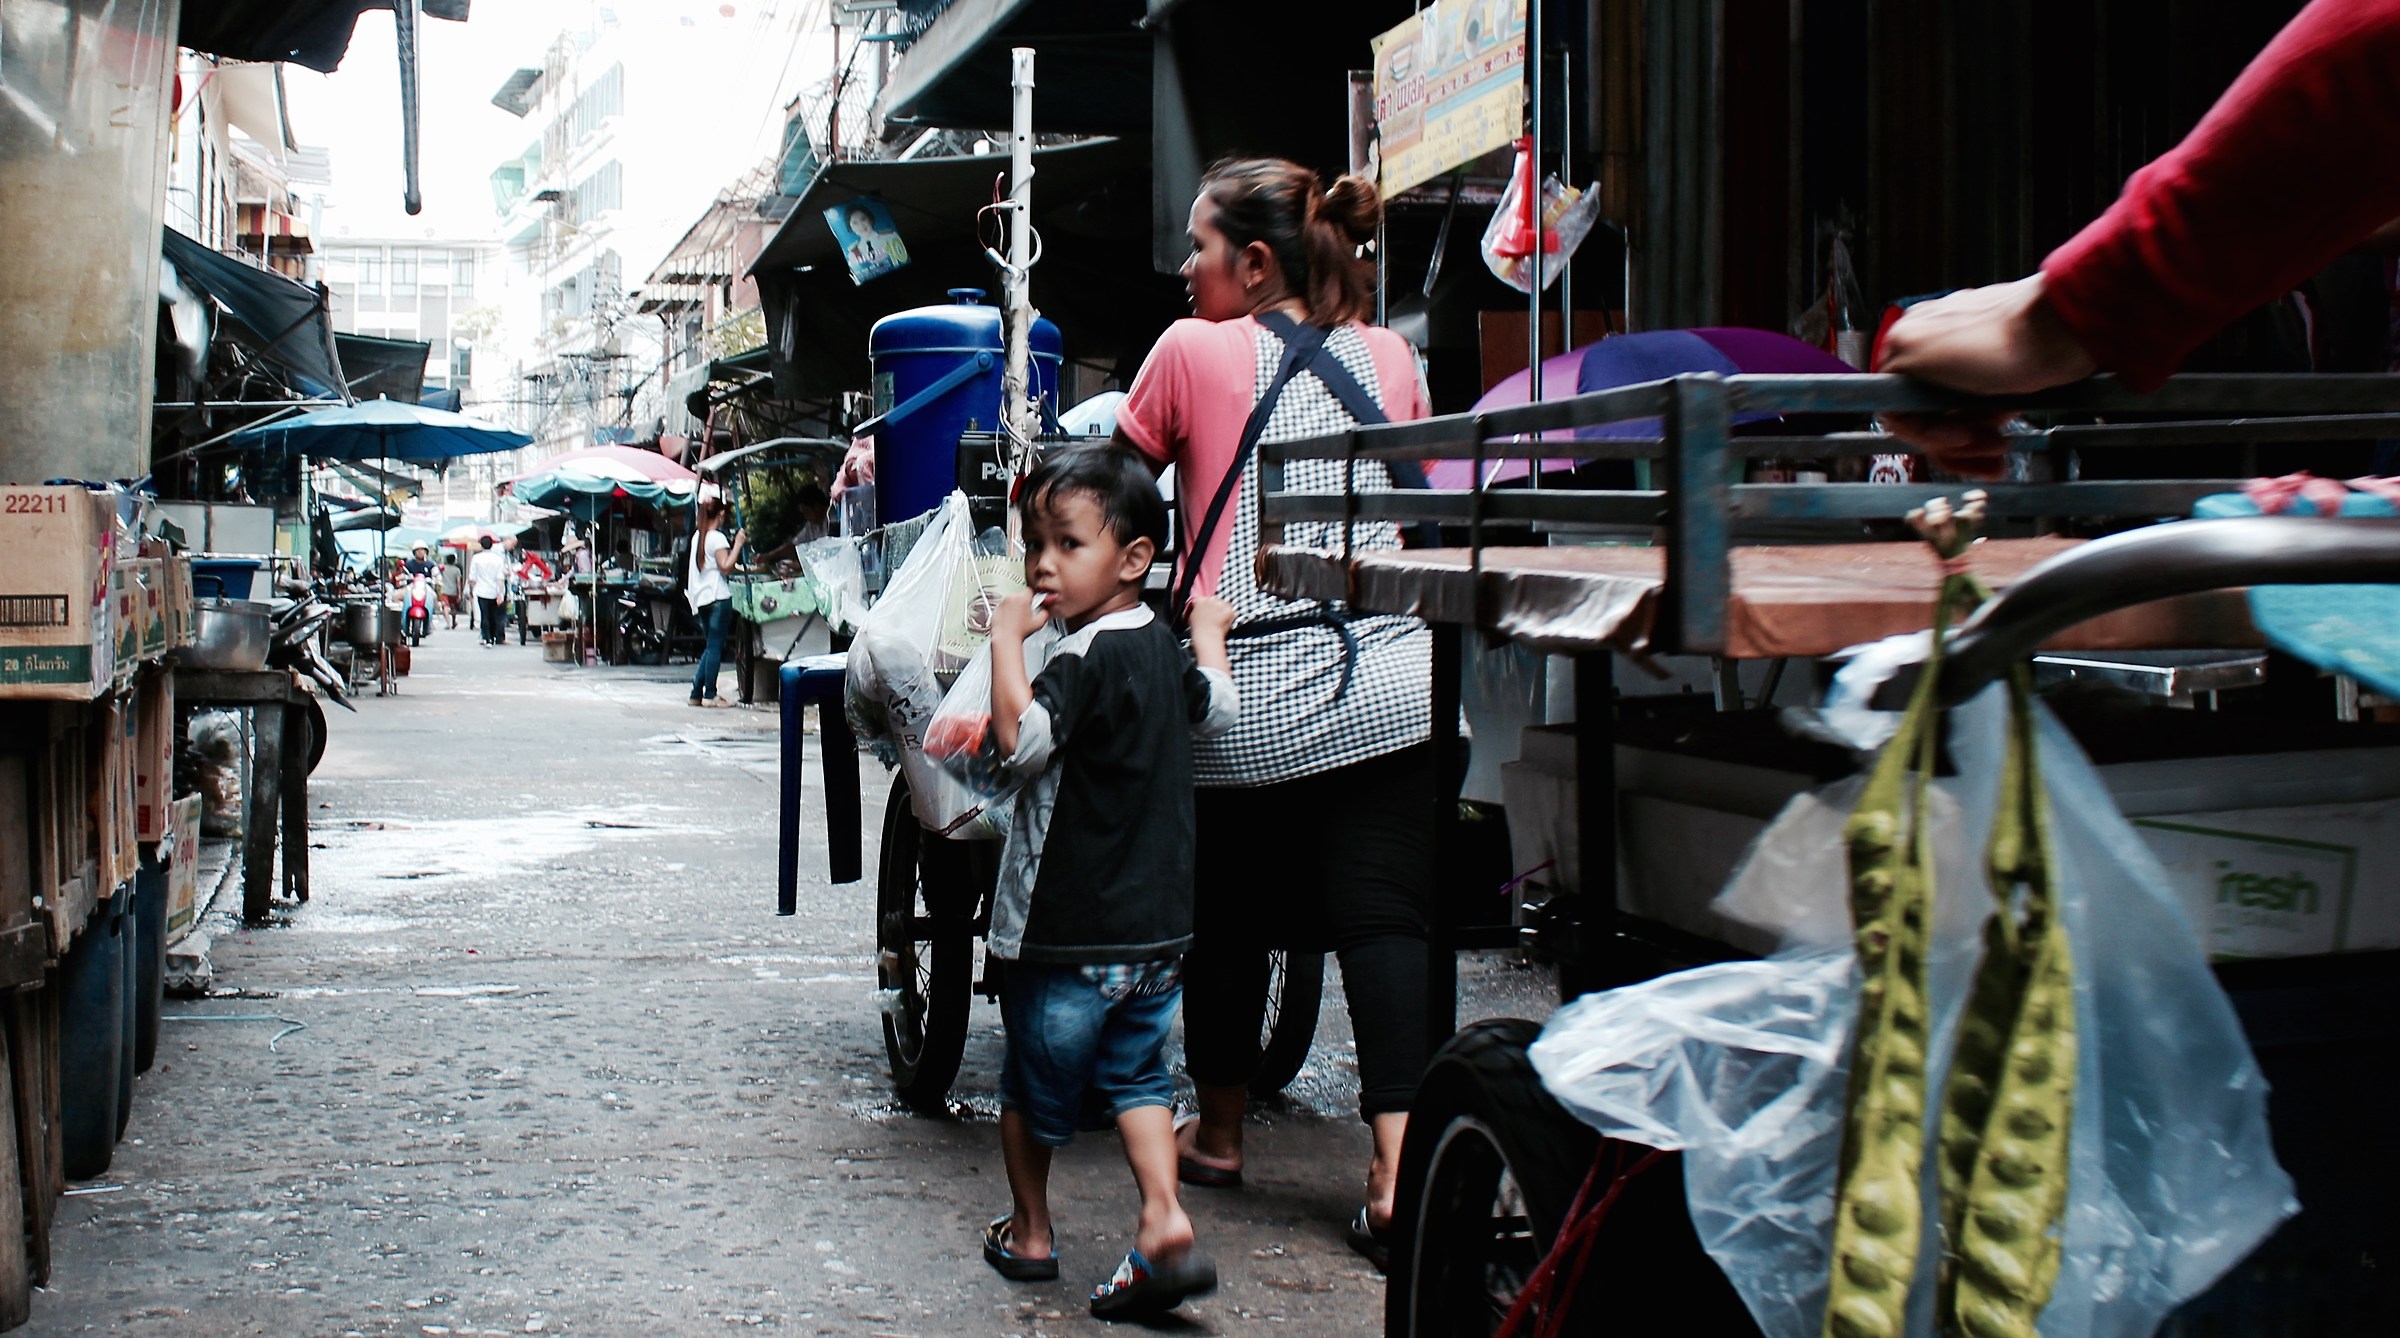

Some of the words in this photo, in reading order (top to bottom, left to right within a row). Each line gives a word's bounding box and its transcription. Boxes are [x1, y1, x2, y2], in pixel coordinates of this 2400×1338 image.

[981, 462, 1008, 480] Pa
[5, 494, 66, 514] 22211
[25, 654, 70, 672] กิโลกรัม
